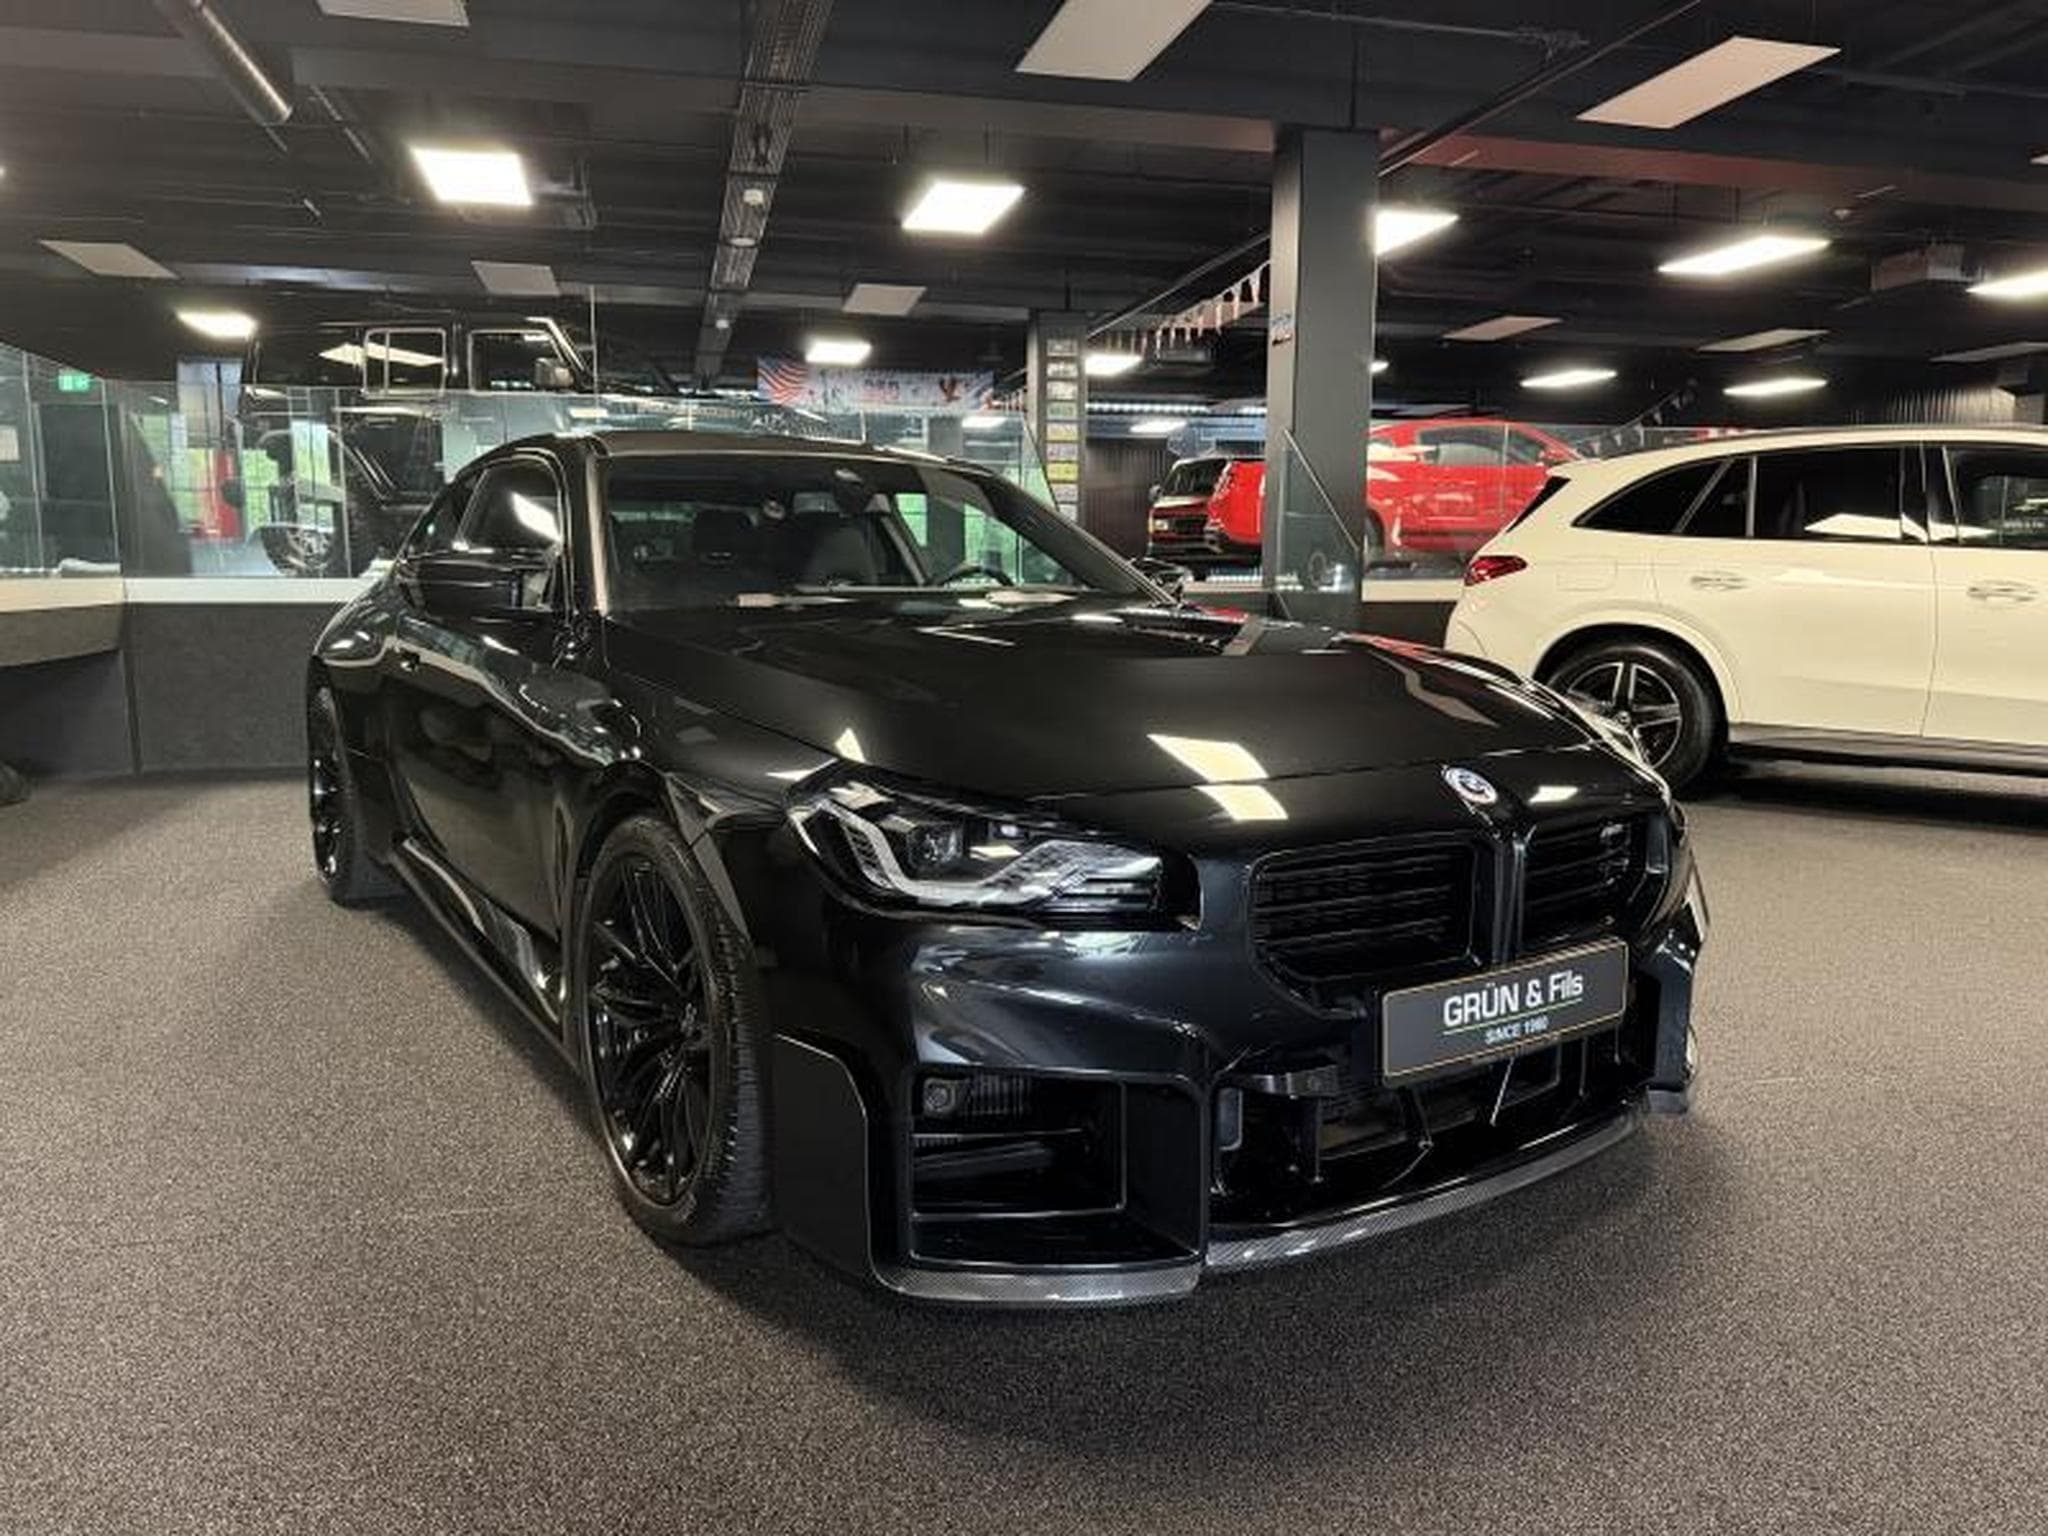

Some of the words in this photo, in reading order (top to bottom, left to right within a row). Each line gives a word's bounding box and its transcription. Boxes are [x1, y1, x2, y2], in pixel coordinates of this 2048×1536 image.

[1444, 982, 1519, 1027] GRÜN
[1526, 979, 1543, 1008] &
[1549, 970, 1583, 1002] Fils
